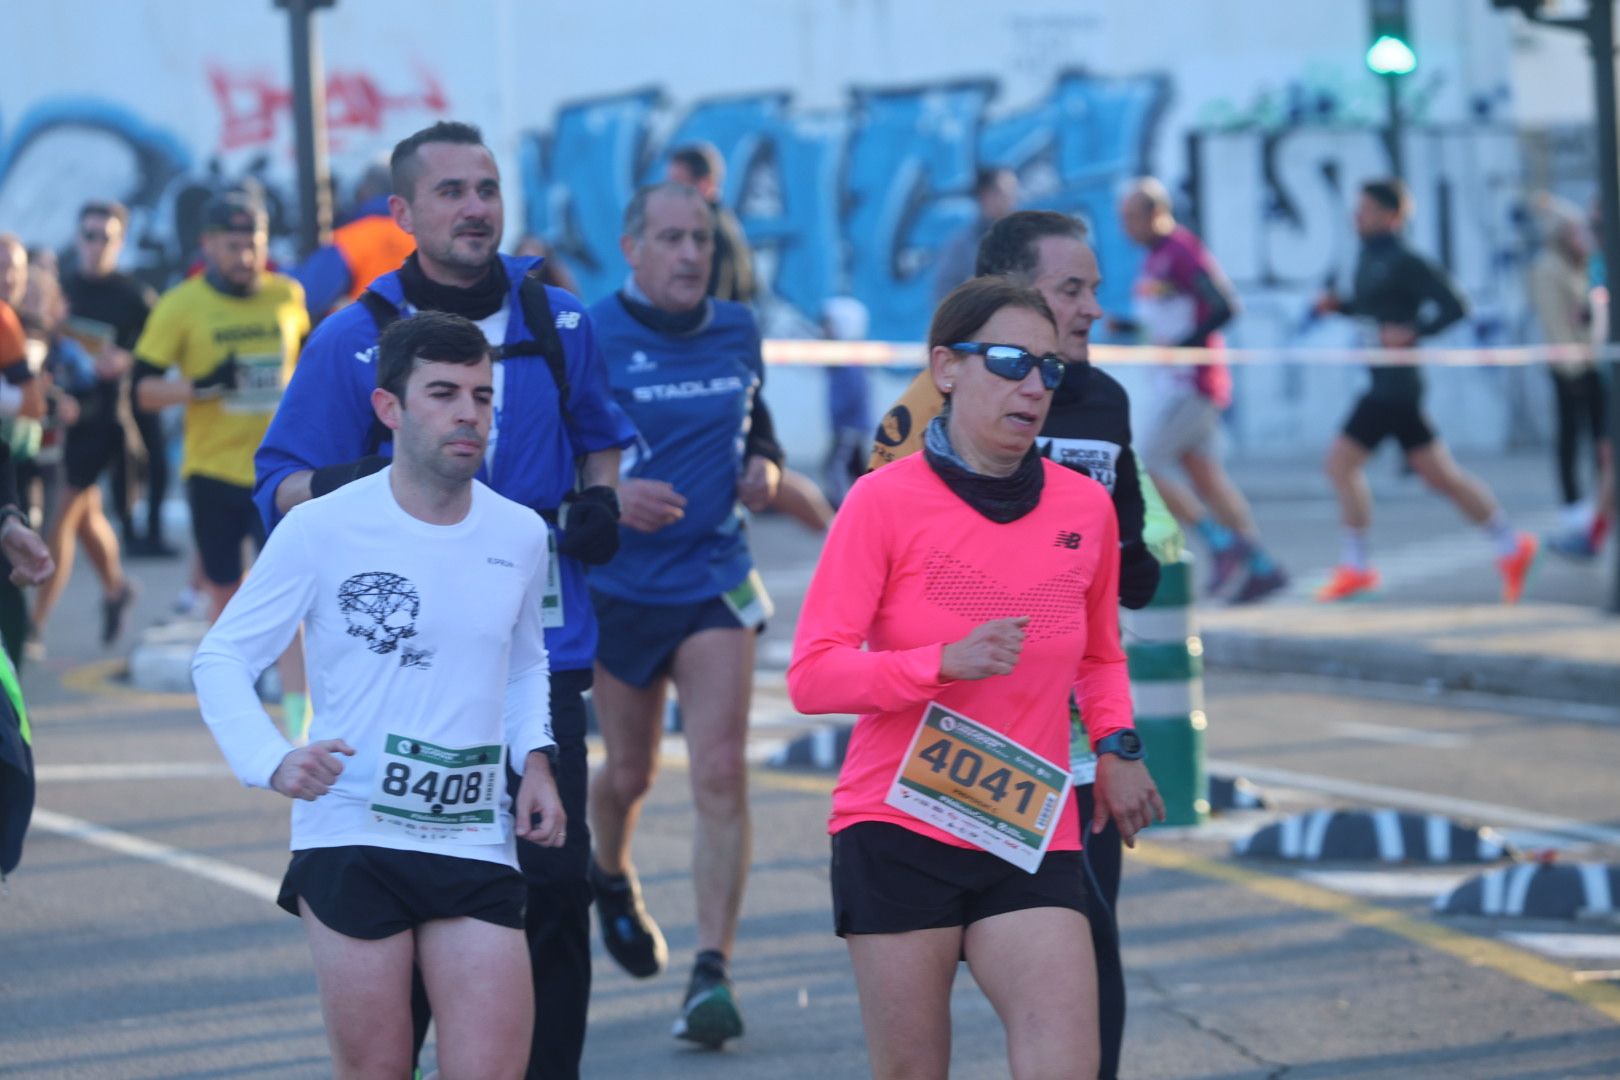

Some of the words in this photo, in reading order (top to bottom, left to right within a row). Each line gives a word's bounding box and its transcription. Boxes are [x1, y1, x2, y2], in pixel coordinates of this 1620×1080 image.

[633, 377, 742, 402] STADLER
[382, 761, 483, 805] 8408
[918, 738, 1037, 815] 4041
